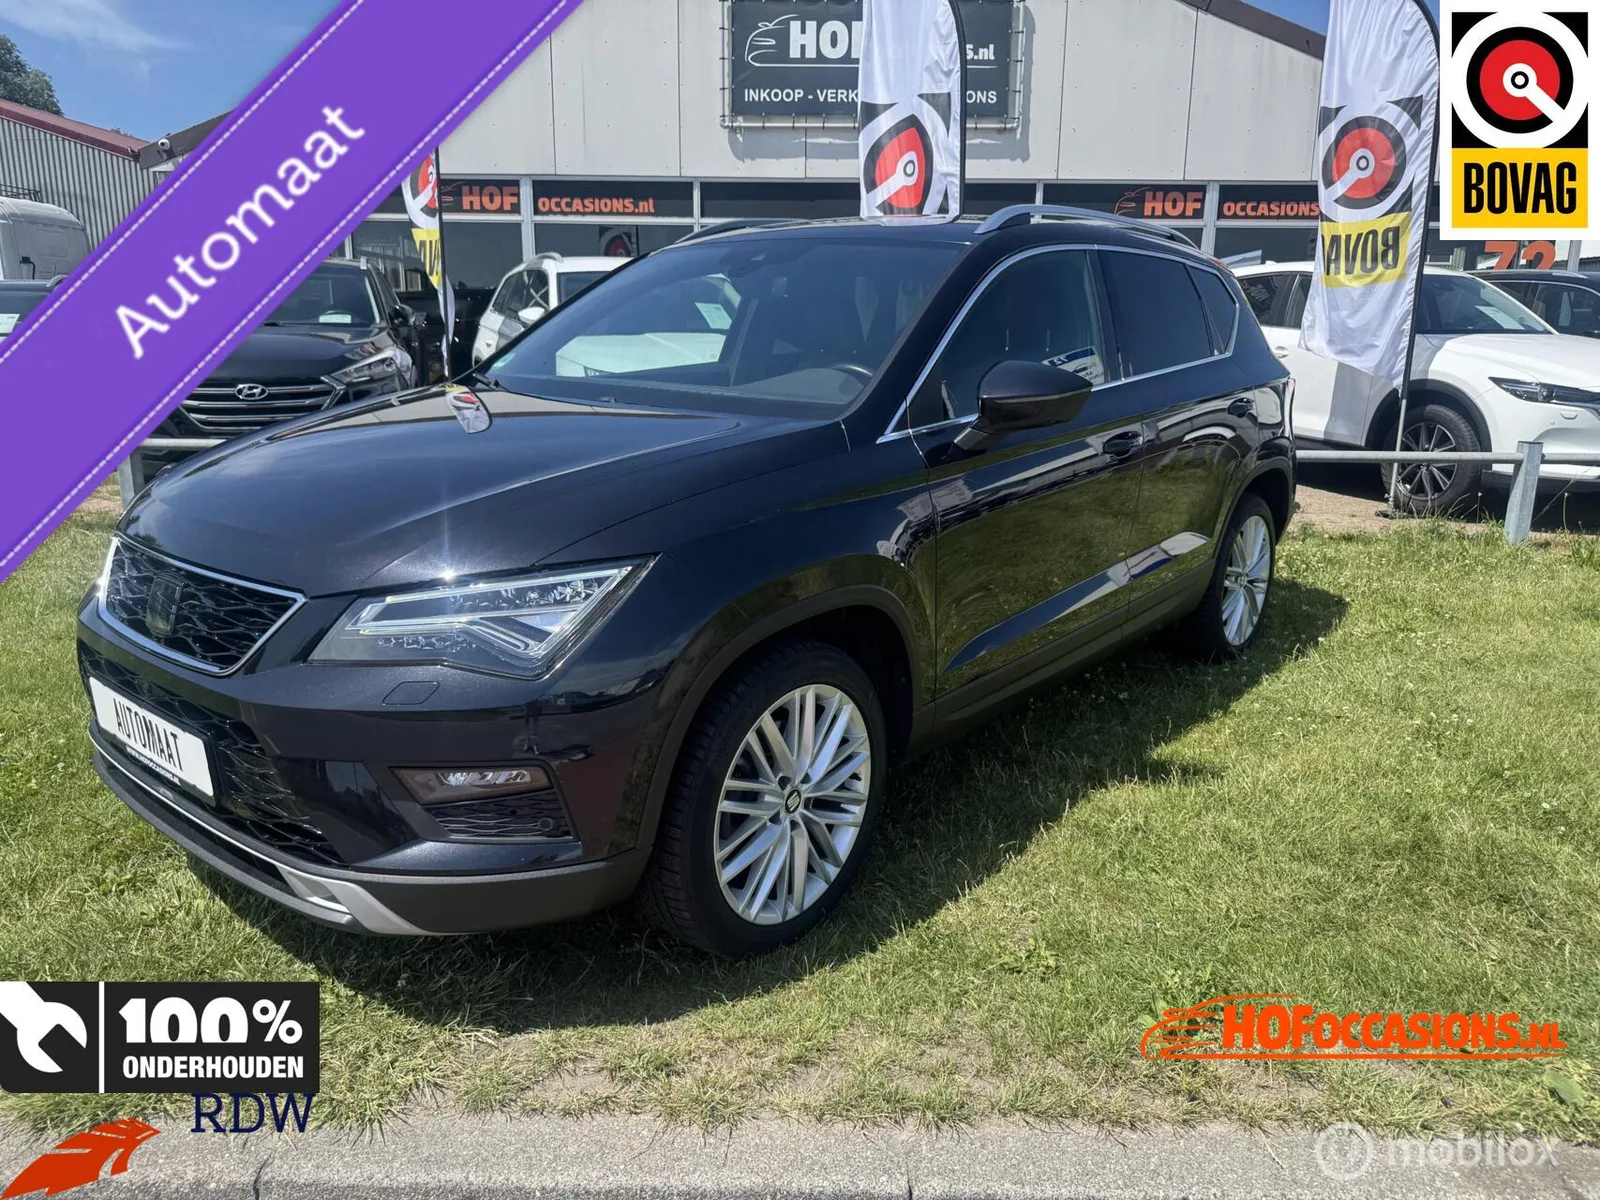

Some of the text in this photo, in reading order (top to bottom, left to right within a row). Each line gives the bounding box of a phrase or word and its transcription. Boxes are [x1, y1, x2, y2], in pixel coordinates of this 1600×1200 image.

[744, 89, 804, 103] INKOOP
[817, 89, 858, 103] VERK
[462, 186, 654, 214] HOF OCCASIONS.nl
[1144, 190, 1320, 217] HOF OCCASIONS
[113, 697, 183, 771] AUTOMAAT
